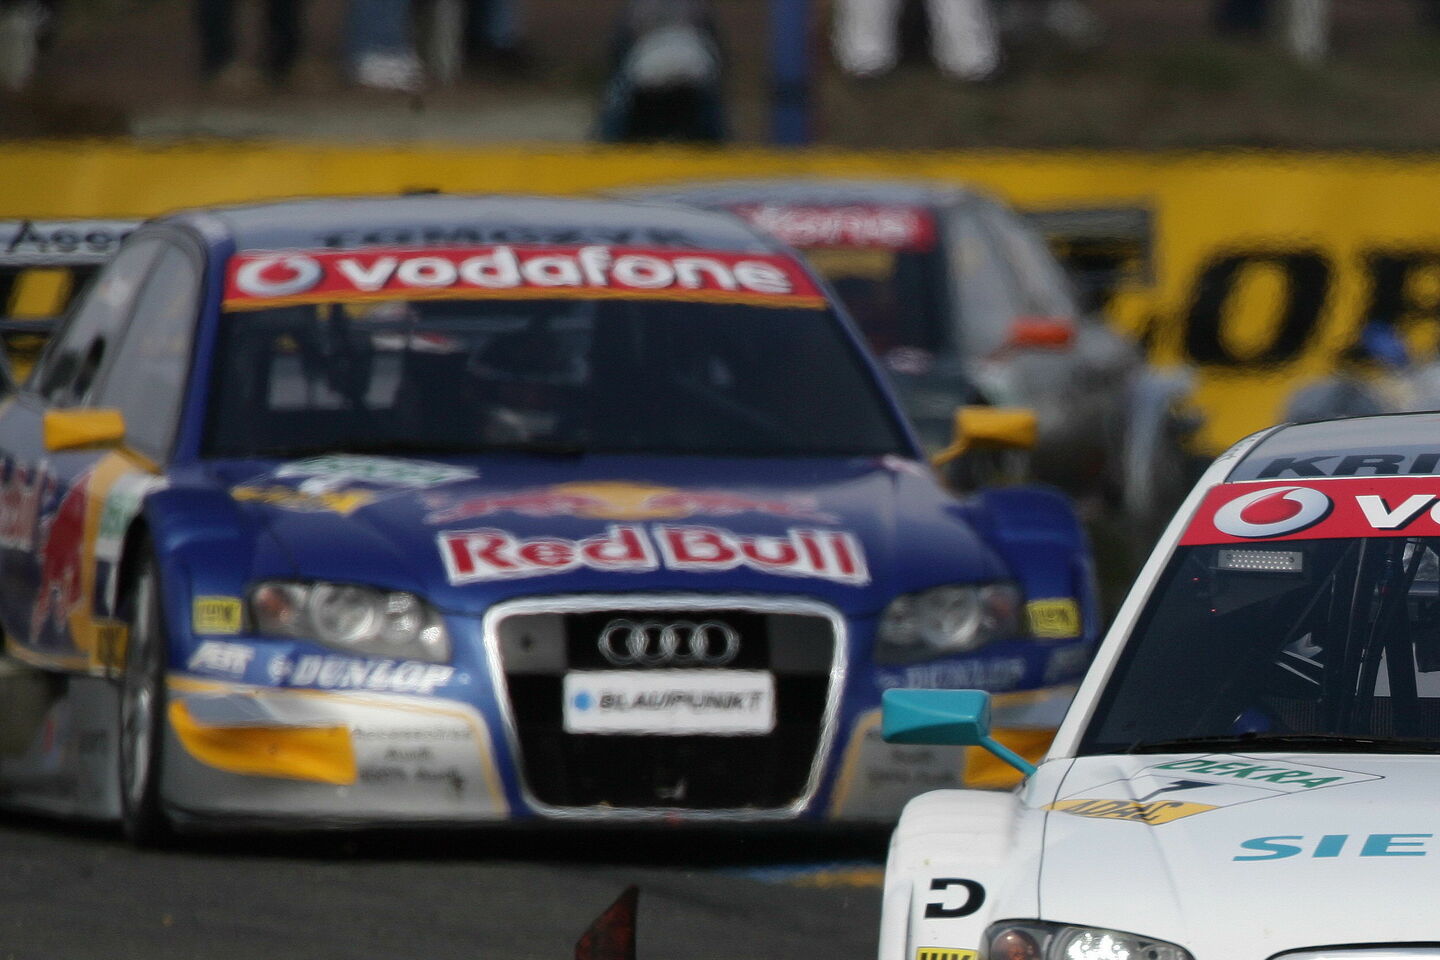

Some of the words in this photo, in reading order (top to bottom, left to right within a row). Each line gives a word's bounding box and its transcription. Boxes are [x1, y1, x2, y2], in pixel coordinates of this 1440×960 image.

[337, 245, 793, 294] vodafone
[444, 525, 656, 582] Red
[658, 525, 866, 582] Bull
[288, 654, 456, 694] DUNLOP
[600, 690, 763, 711] BLAUPUNKT
[1153, 759, 1345, 789] DEKRA
[1062, 799, 1185, 821] ADAC
